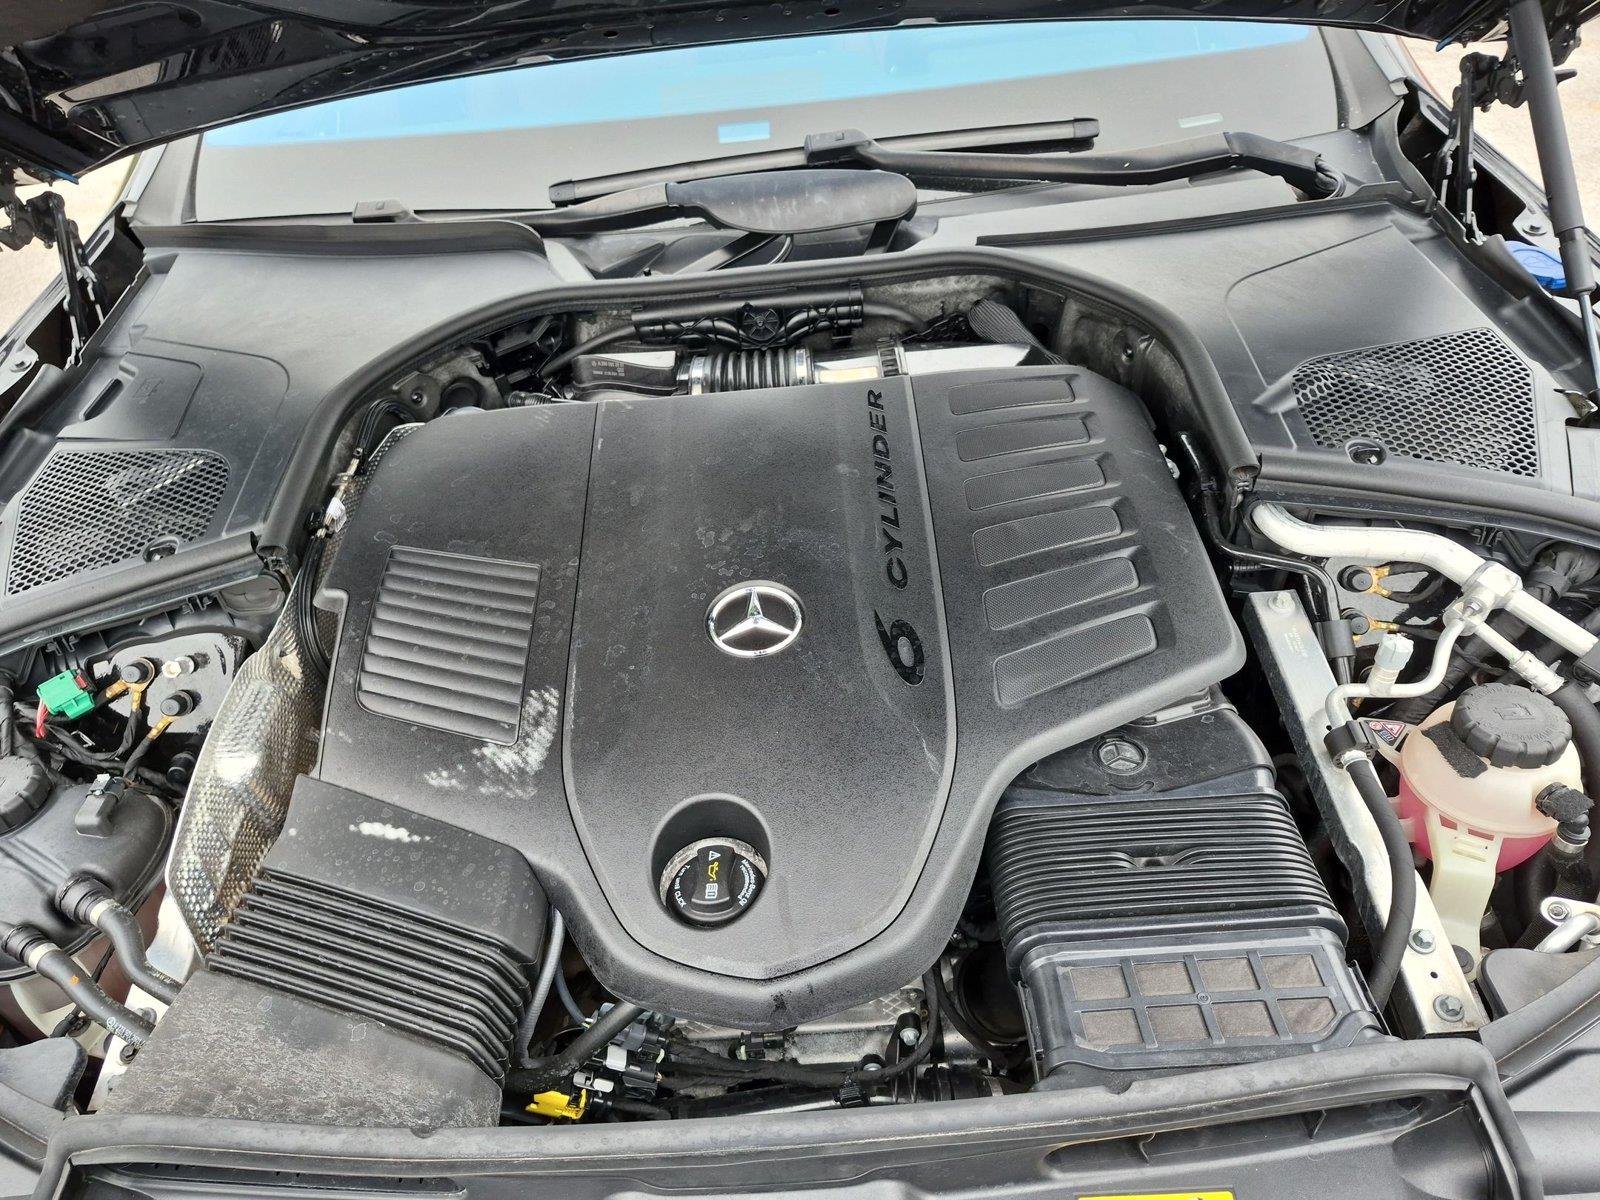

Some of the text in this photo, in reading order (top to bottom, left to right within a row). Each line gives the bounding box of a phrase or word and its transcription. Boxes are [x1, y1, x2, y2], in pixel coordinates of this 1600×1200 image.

[867, 389, 925, 686] 6 CYLINDER
[674, 890, 687, 907] CLICK
